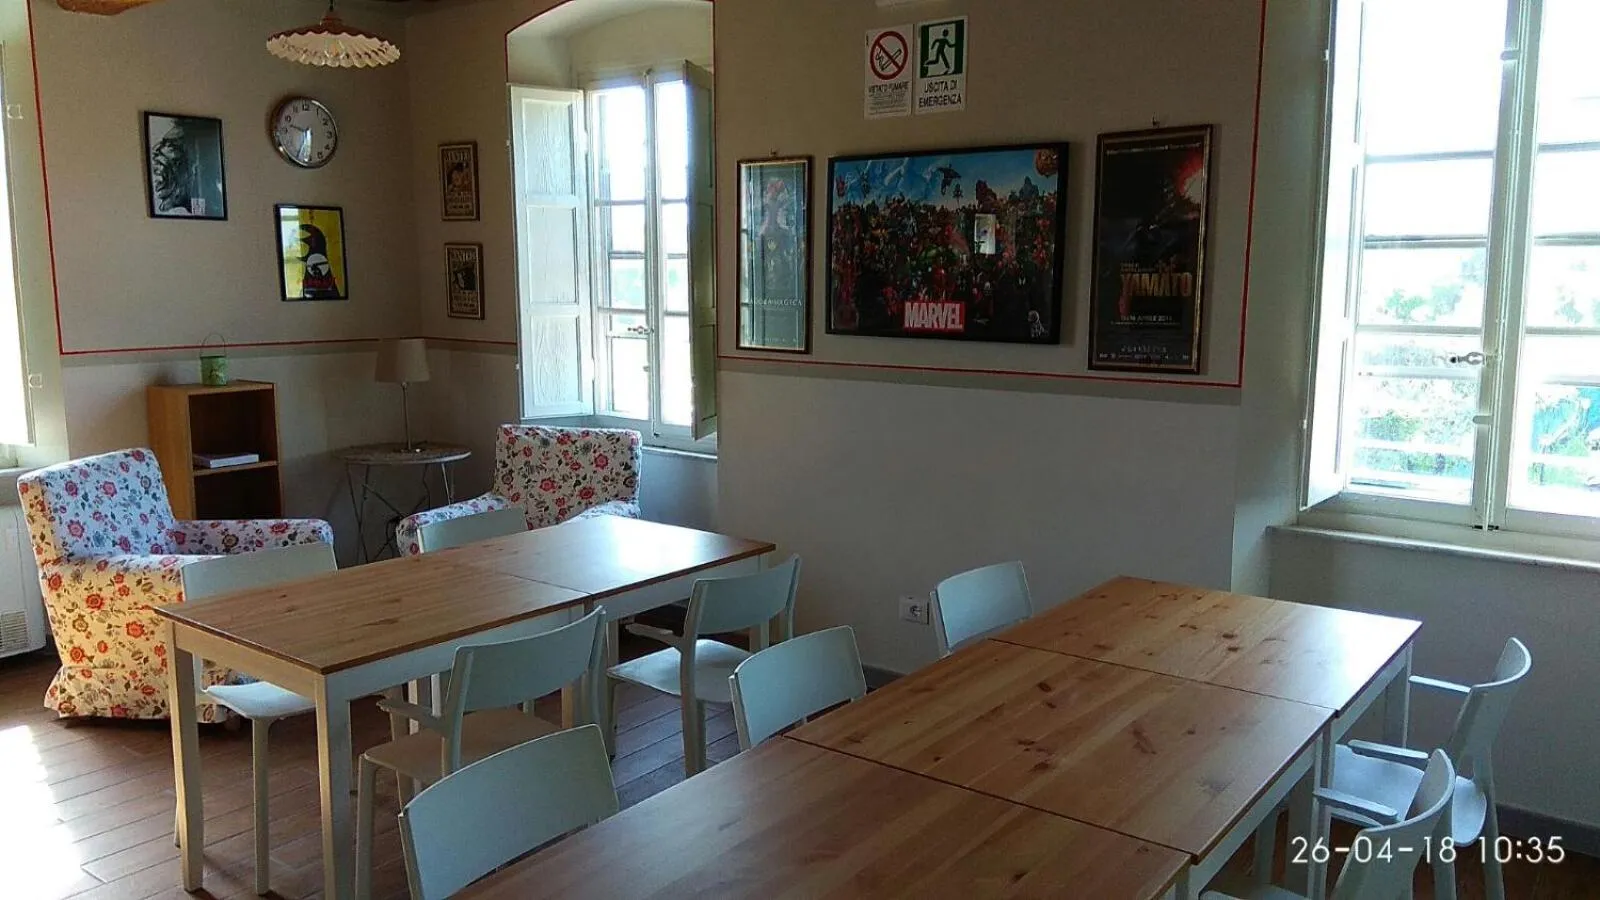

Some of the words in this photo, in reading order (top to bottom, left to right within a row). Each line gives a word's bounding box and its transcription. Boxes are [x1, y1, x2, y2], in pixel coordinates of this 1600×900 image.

[924, 80, 949, 93] USCITA
[950, 79, 957, 90] DI
[302, 103, 310, 111] 12
[918, 93, 962, 108] EMERGENZA
[1120, 271, 1193, 297] YAMATO
[904, 301, 963, 330] MARVEL
